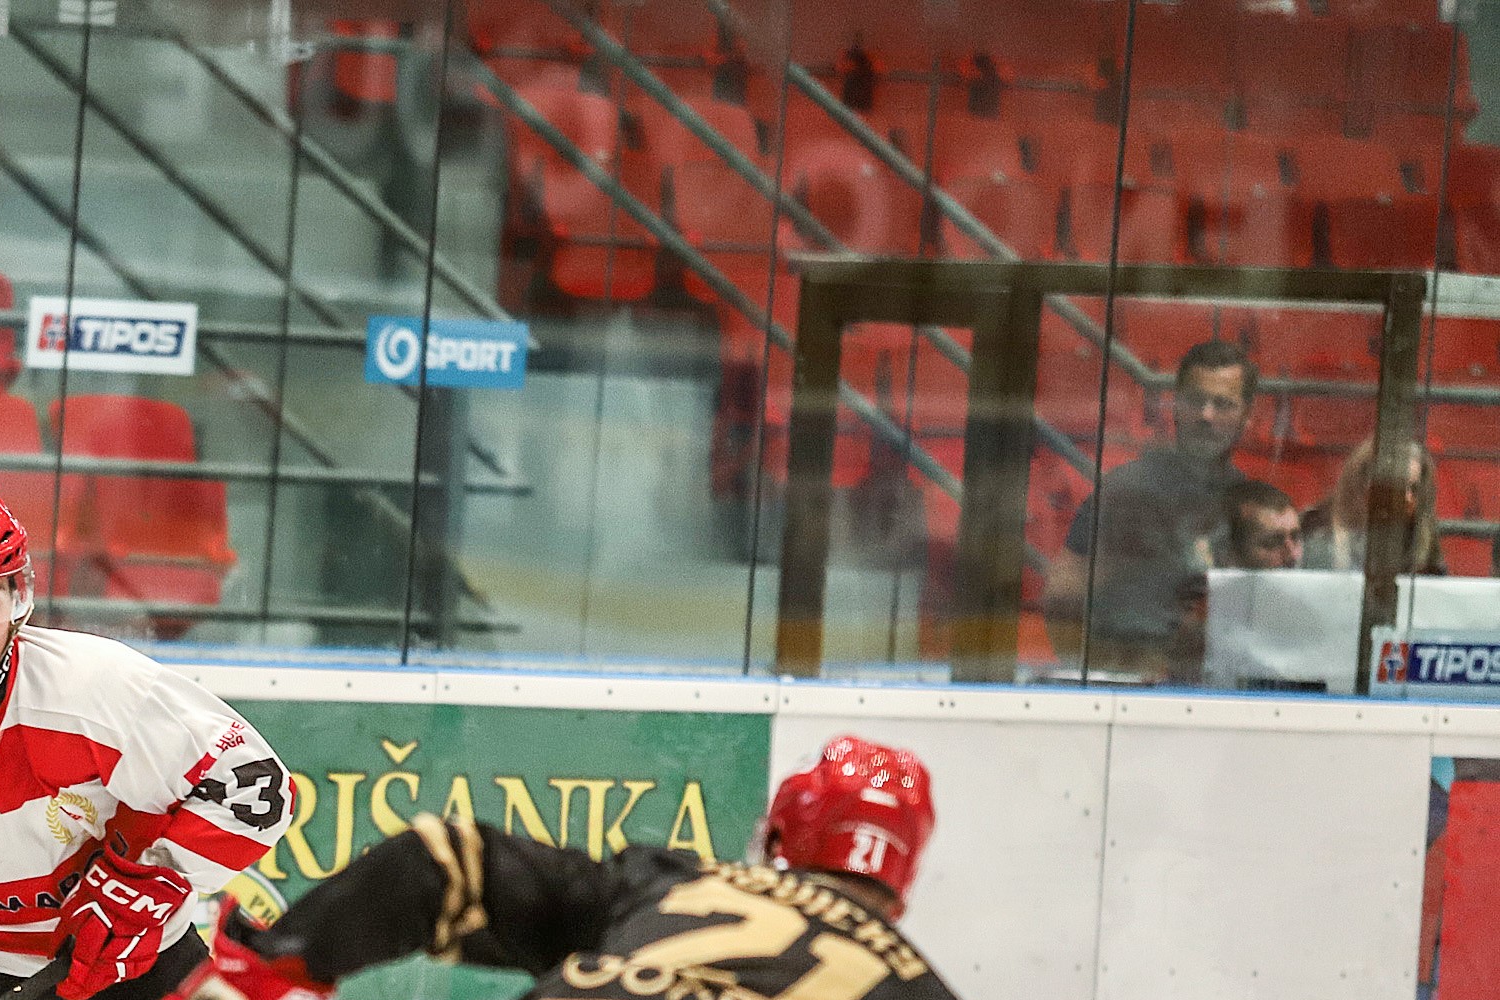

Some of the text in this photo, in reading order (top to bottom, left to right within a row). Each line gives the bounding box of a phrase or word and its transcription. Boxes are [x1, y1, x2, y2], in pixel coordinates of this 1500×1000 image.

[82, 318, 178, 353] TIPOS
[847, 824, 888, 874] 21
[84, 864, 173, 920] CCM
